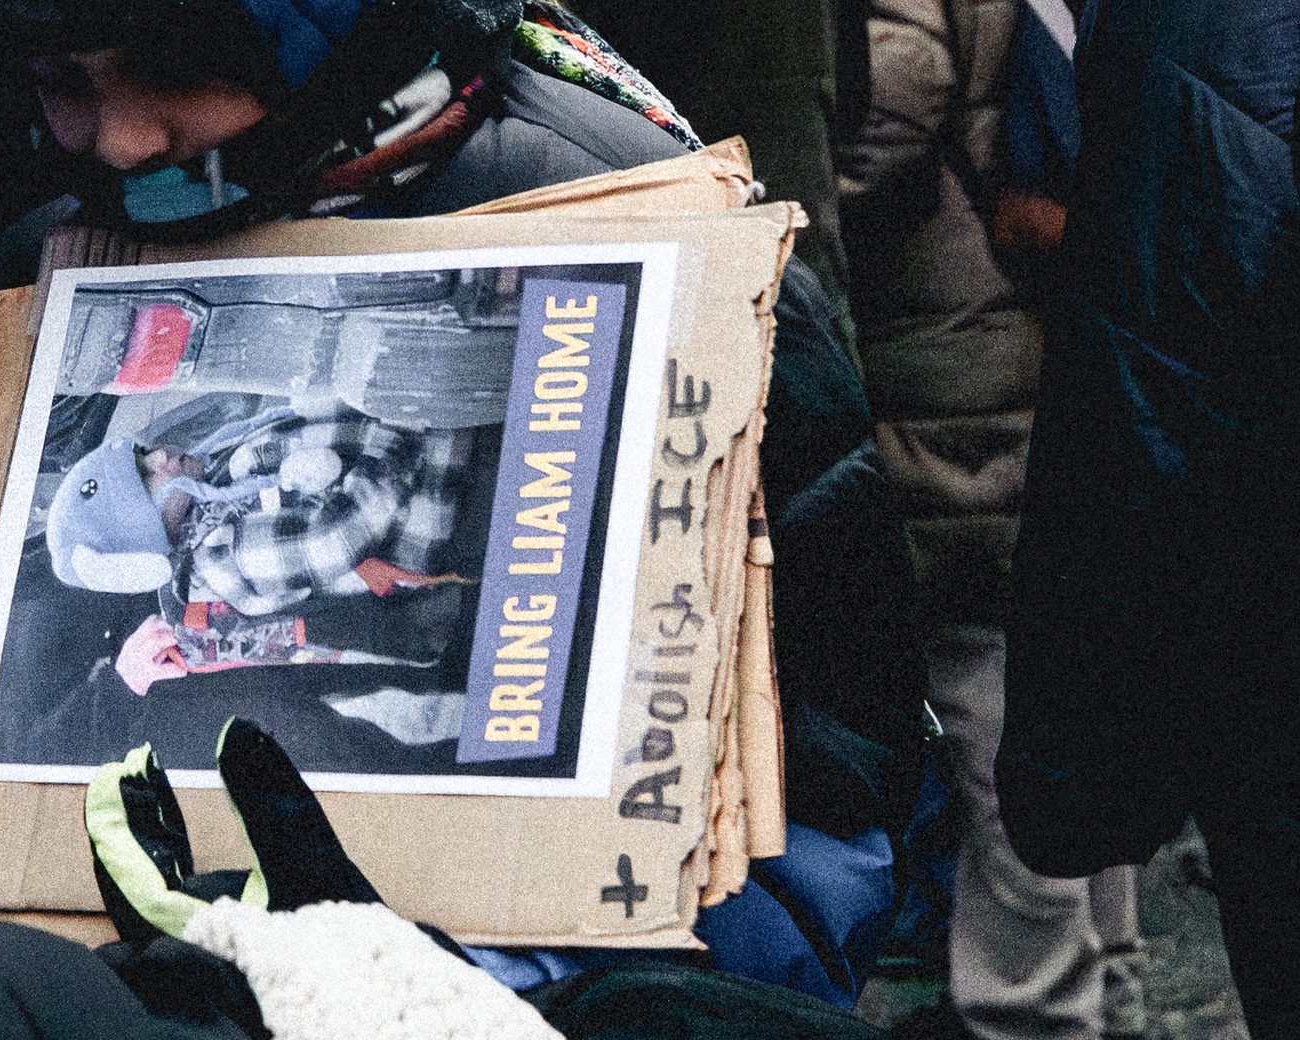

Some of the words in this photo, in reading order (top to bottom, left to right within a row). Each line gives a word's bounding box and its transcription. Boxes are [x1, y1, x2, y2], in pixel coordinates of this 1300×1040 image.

[528, 294, 598, 432] HOME
[508, 451, 577, 575] LIAM
[650, 357, 712, 545] ICE
[484, 593, 558, 743] BRING
